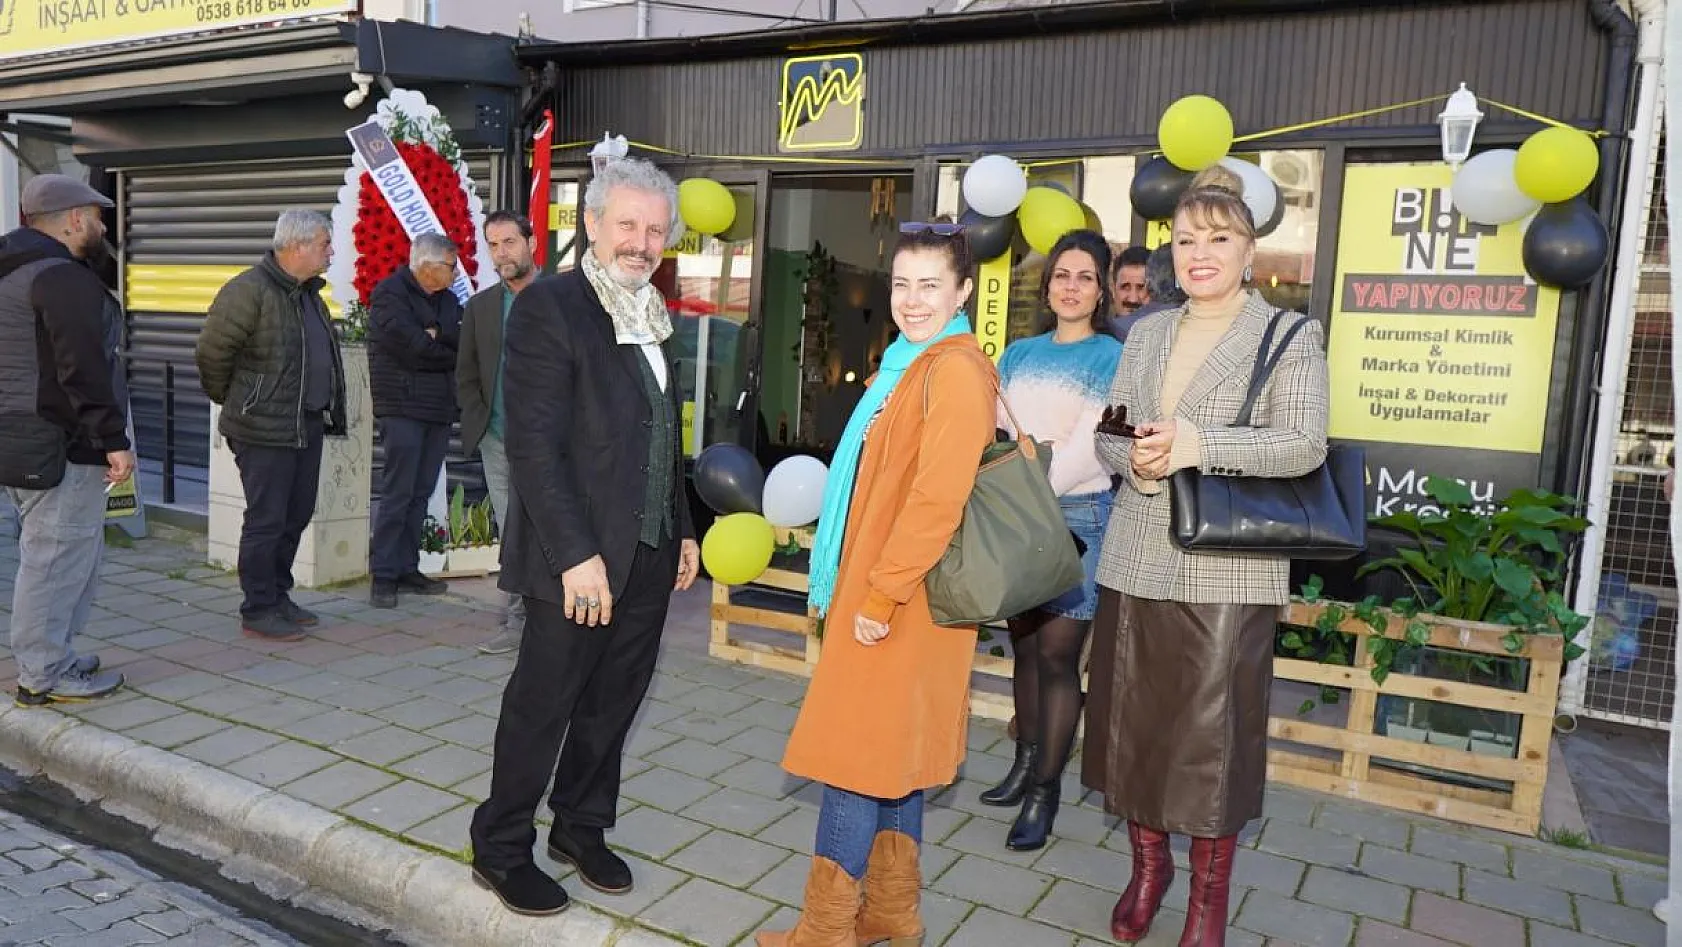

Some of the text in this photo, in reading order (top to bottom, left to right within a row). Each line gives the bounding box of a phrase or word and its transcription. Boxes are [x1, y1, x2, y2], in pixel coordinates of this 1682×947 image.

[197, 3, 230, 21] 0538
[236, 0, 262, 15] 618
[378, 165, 414, 203] GOLD
[1405, 232, 1477, 270] NE
[1352, 281, 1527, 312] YAPIYORUZ
[1364, 326, 1514, 345] Kurumsal Kimlik
[1429, 344, 1443, 357] &
[1361, 357, 1512, 377] Marka Yönetimi
[1405, 387, 1418, 400] &
[1424, 388, 1508, 406] Dekoratif
[1369, 402, 1492, 423] Uygulamalar
